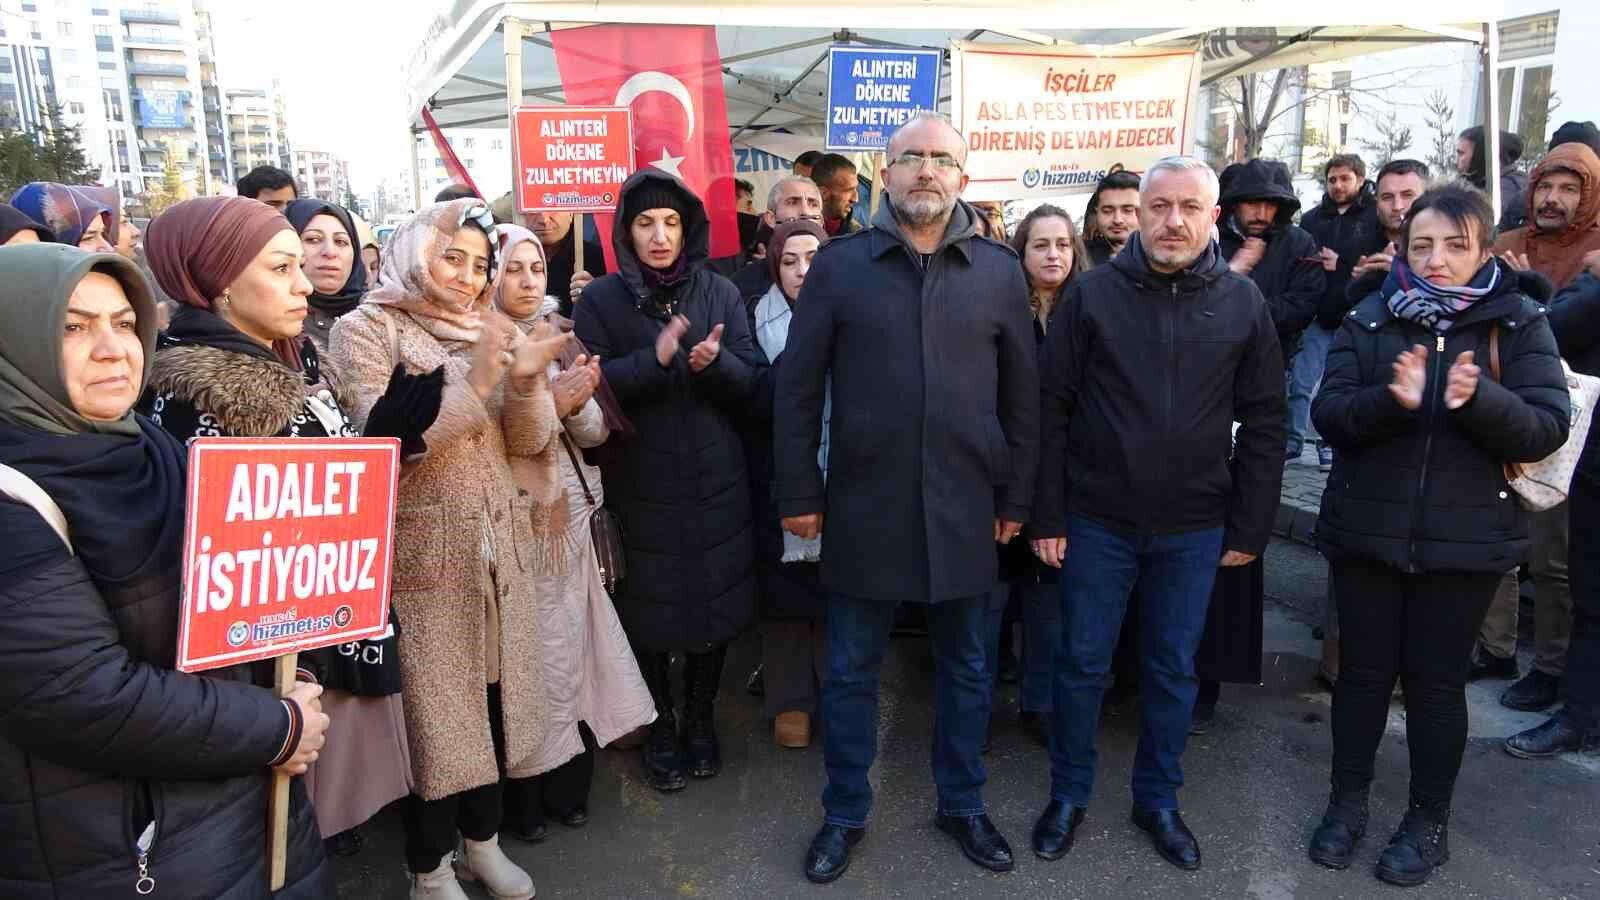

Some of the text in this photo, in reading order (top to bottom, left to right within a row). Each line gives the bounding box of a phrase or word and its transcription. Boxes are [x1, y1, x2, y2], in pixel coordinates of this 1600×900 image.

[852, 56, 917, 79] ALINTERİ
[855, 80, 911, 102] DÖKENE
[1044, 68, 1116, 96] İŞÇİLER
[833, 104, 933, 126] ZULMETMEYİ
[977, 99, 1176, 121] ASLA PES ETMEYECEK
[541, 115, 608, 137] ALINTERİ
[546, 139, 605, 161] DÖKENE
[969, 126, 1176, 155] DİRENİŞ DEVAM EDECEK
[526, 162, 627, 185] ZULMETMEYİN
[225, 461, 366, 522] ADALET
[195, 531, 379, 613] İSTİYORUZ
